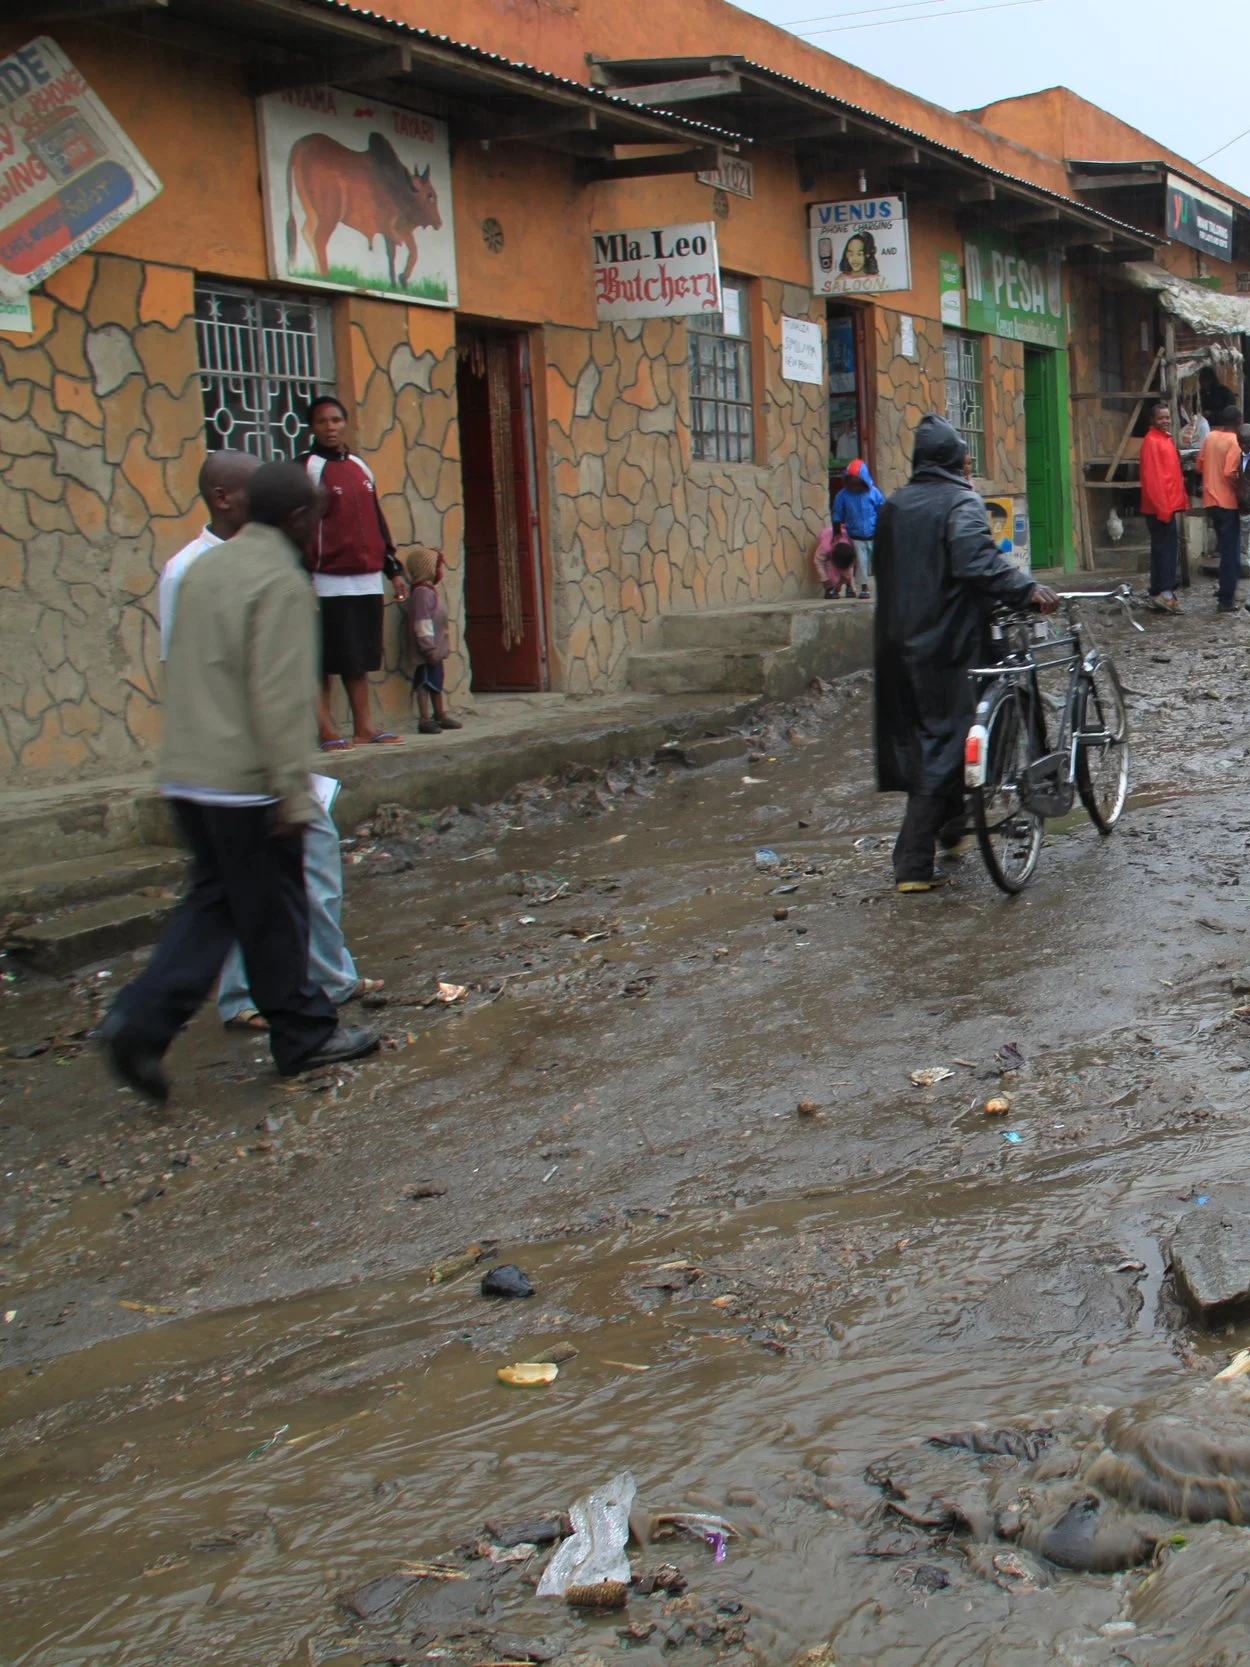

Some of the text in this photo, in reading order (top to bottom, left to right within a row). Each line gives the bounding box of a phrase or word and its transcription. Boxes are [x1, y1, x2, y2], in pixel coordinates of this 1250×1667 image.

[818, 201, 892, 224] VENUS
[821, 221, 893, 234] PHONE CHARGING
[881, 247, 898, 255] AND
[593, 262, 719, 309] Butchery
